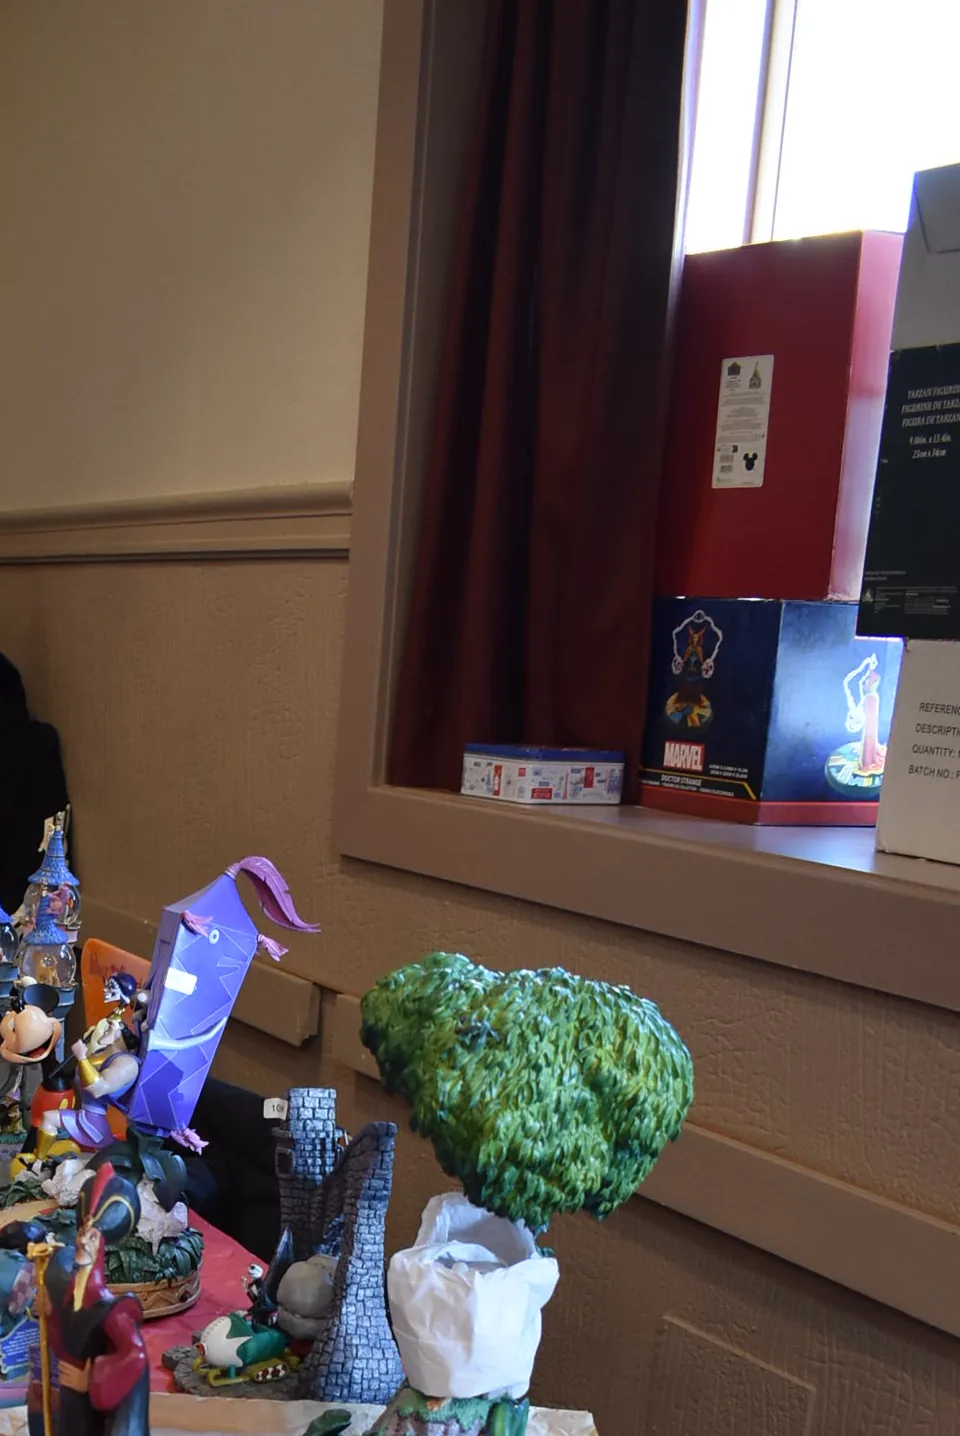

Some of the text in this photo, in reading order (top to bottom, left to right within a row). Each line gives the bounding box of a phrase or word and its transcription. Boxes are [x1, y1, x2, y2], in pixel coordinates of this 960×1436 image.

[663, 741, 704, 772] MARVEL
[908, 764, 935, 777] BATCH
[661, 774, 702, 787] DOCTOR STRANGE
